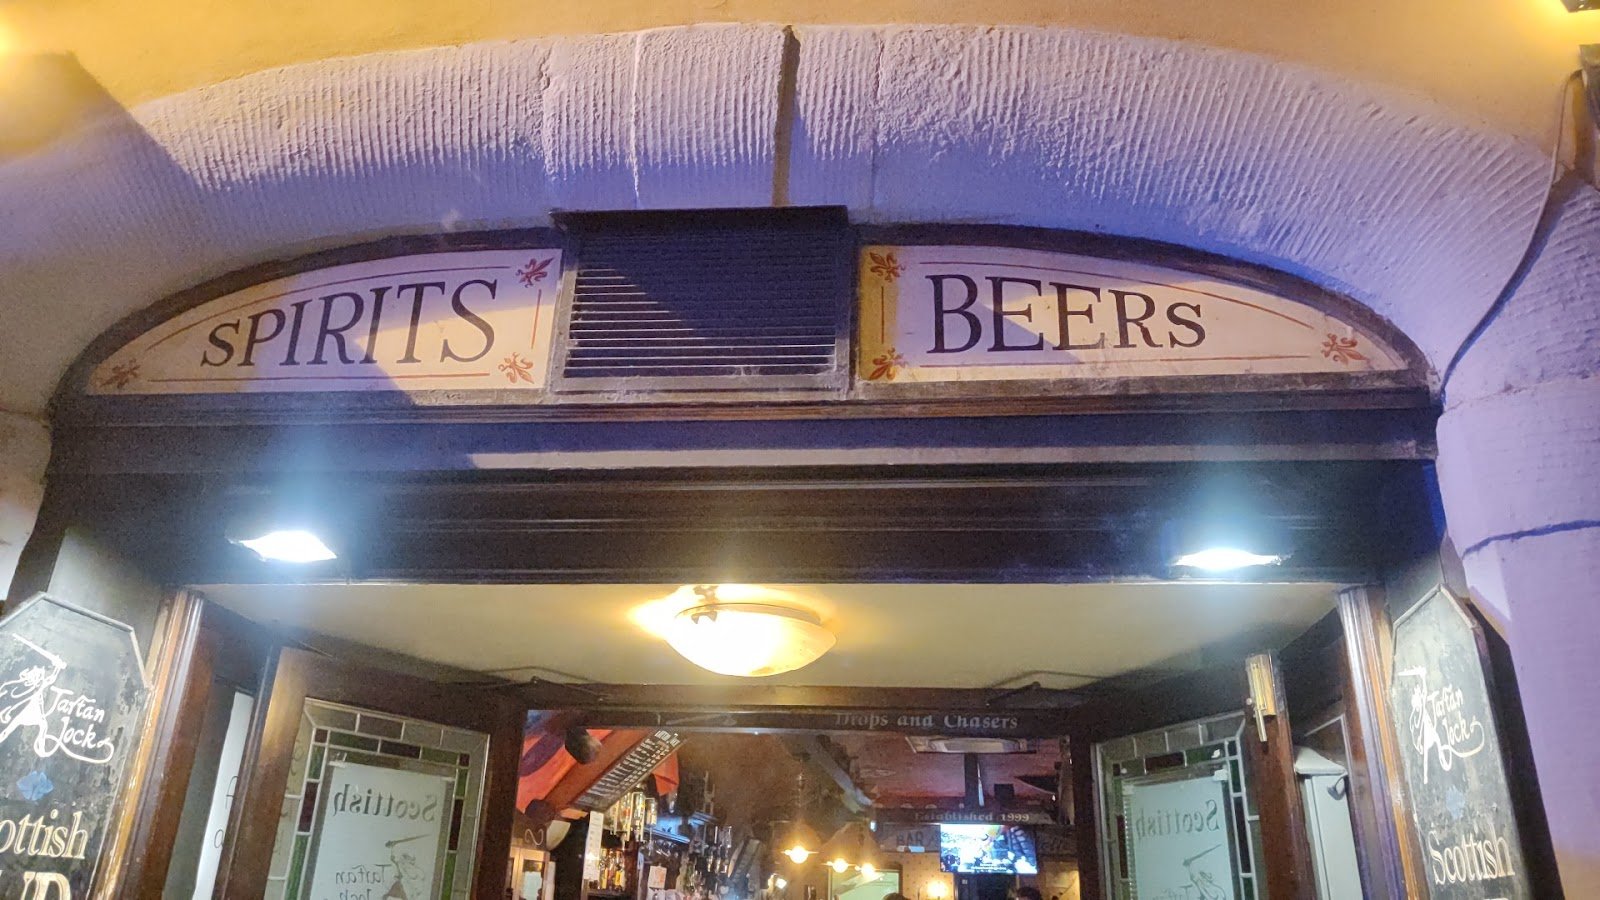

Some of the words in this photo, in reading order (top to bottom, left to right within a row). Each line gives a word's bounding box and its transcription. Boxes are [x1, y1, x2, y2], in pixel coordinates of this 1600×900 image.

[201, 279, 498, 367] SPIRITS
[925, 274, 1206, 355] BEERS
[46, 686, 104, 723] Tartan
[835, 712, 888, 730] Drops
[897, 713, 933, 728] and
[944, 713, 1018, 728] Chasers
[1427, 684, 1464, 728] Tartan
[54, 718, 106, 752] Jock
[1440, 711, 1471, 749] Jock
[0, 808, 86, 860] ottish
[1001, 813, 1030, 823] 1999
[1428, 821, 1515, 885] Scottish
